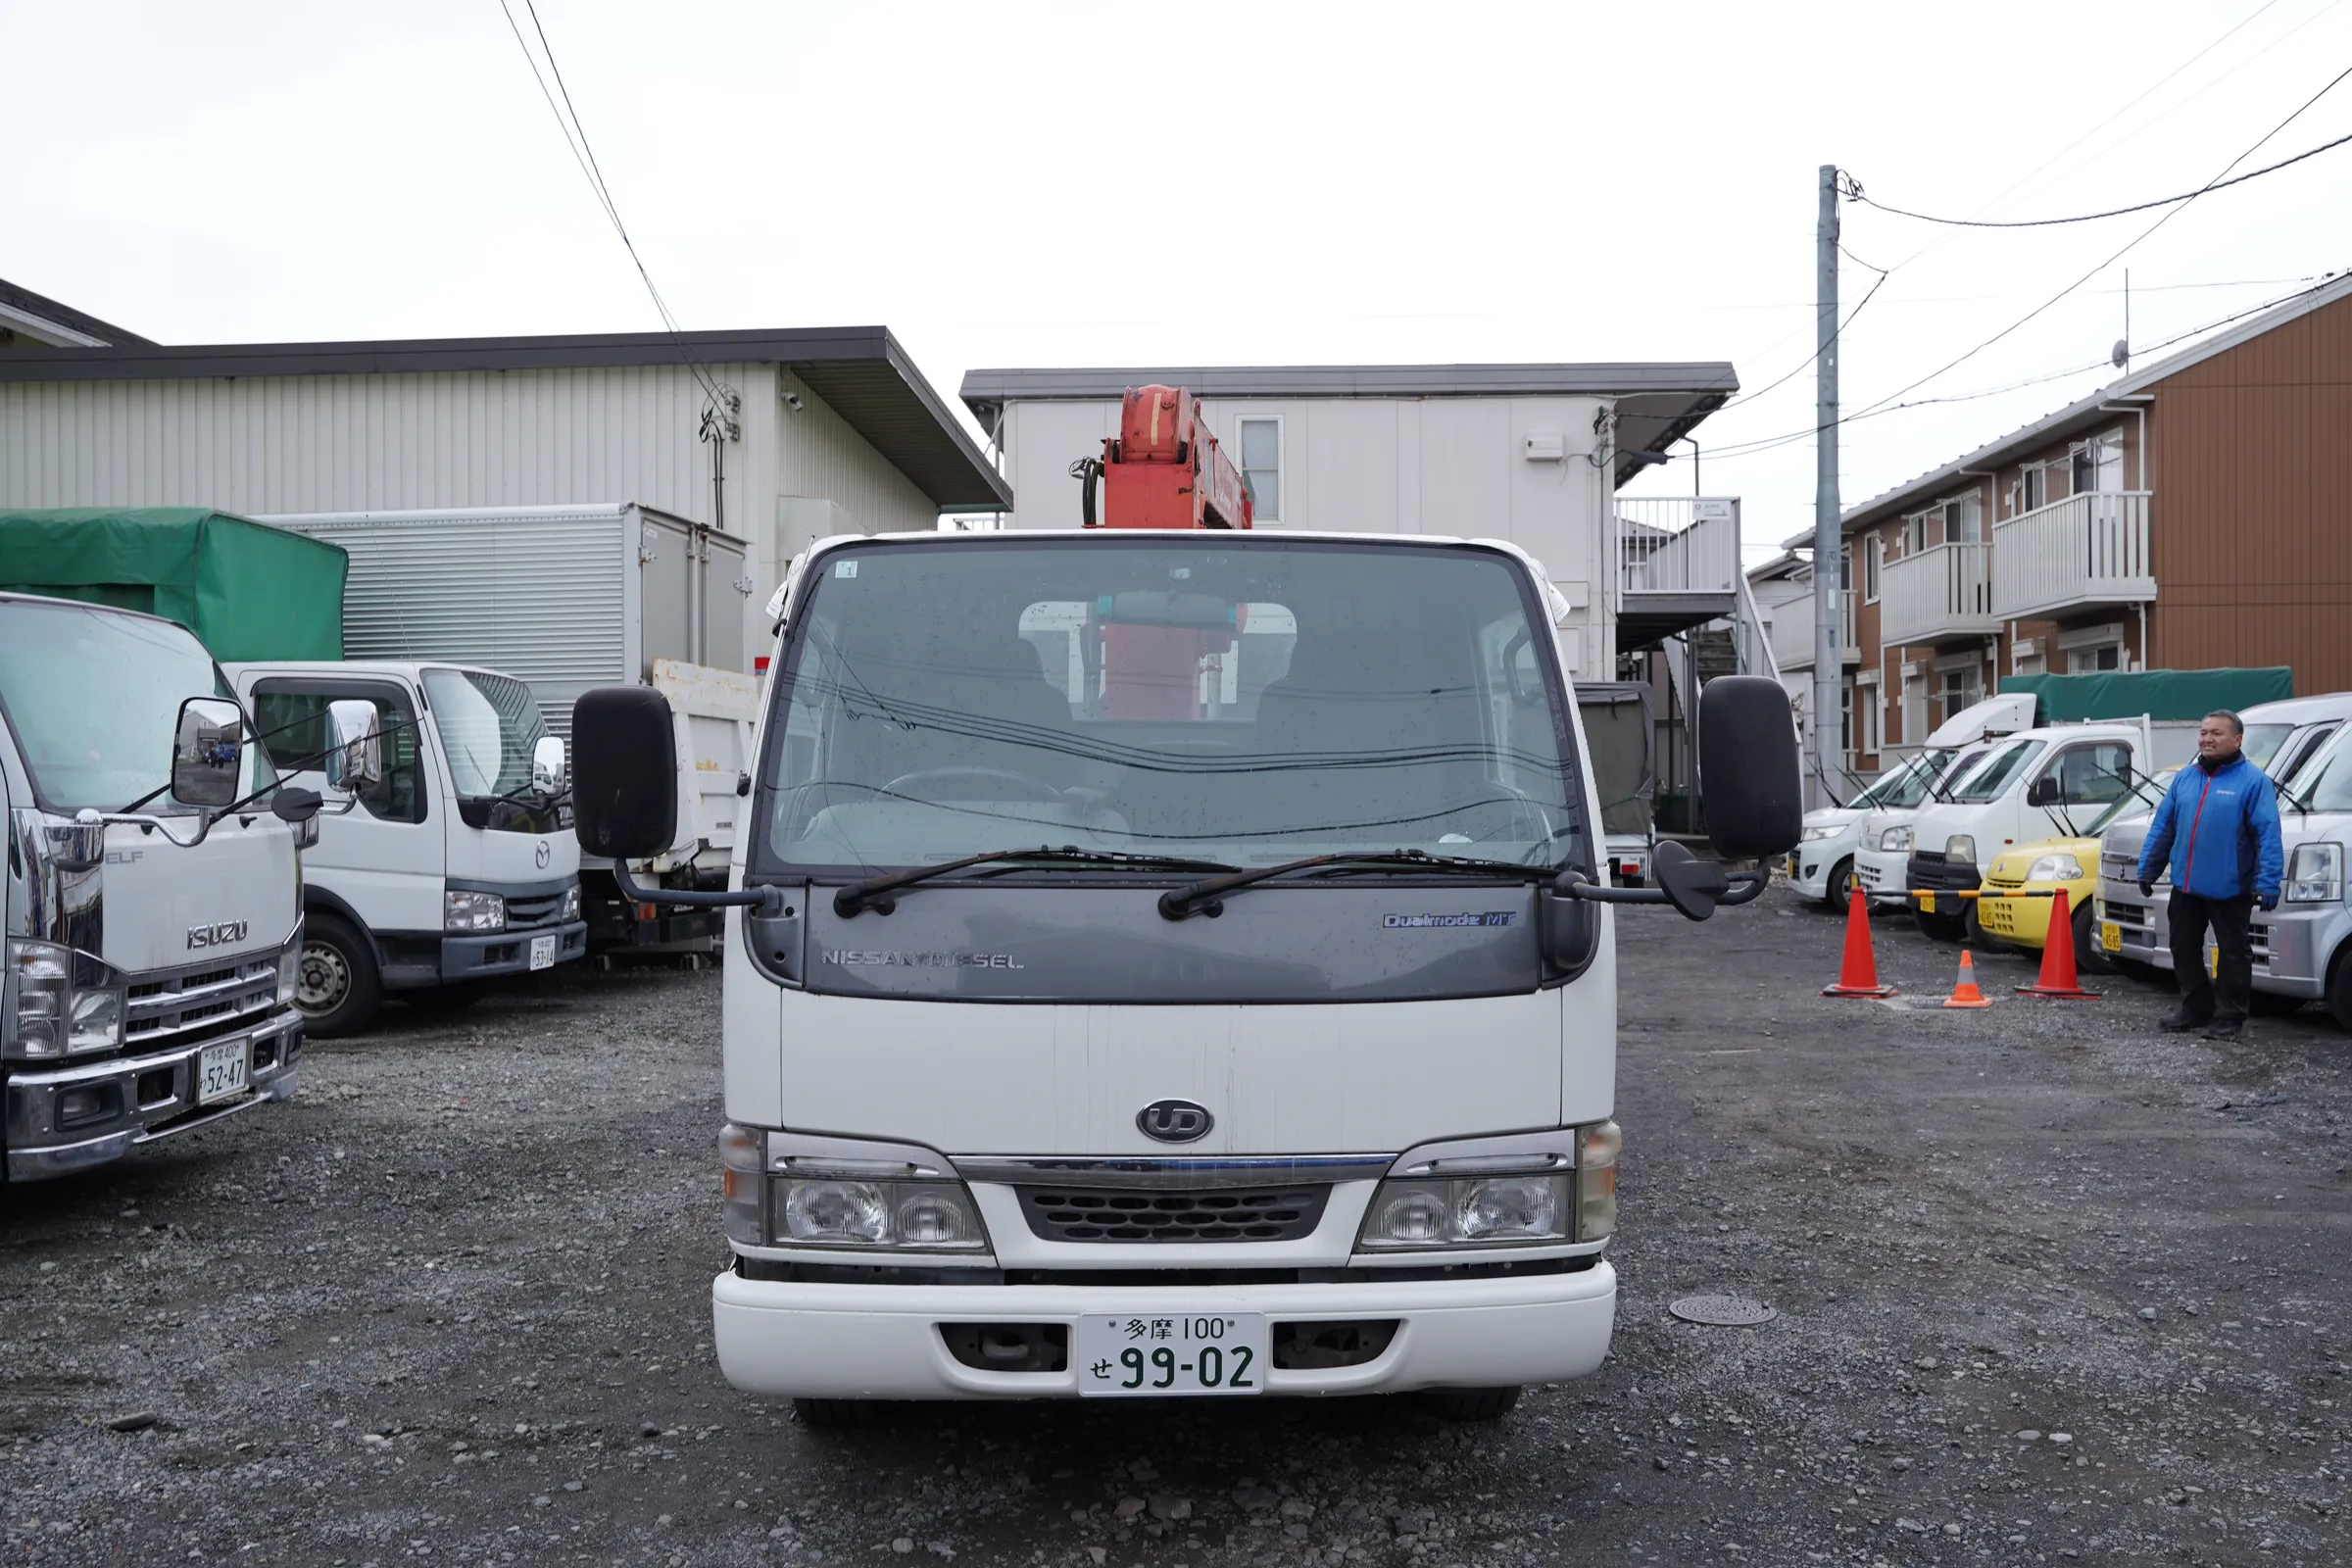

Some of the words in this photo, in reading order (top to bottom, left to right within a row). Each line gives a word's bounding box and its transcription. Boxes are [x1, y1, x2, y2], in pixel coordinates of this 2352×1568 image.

[105, 851, 144, 865] ELF
[1383, 912, 1481, 928] Dualmode
[1484, 911, 1517, 926] MT
[186, 918, 249, 950] ISUZU
[536, 949, 554, 967] 53-14
[821, 950, 916, 966] NISSAN
[928, 951, 1025, 969] DIESEL
[224, 1044, 237, 1059] 400
[208, 1058, 244, 1094] 52-47
[1147, 1107, 1206, 1135] UD
[1123, 1318, 1174, 1340] 多摩
[1184, 1317, 1225, 1340] 100
[1089, 1358, 1113, 1379] せ
[1120, 1346, 1254, 1389] 99-02
